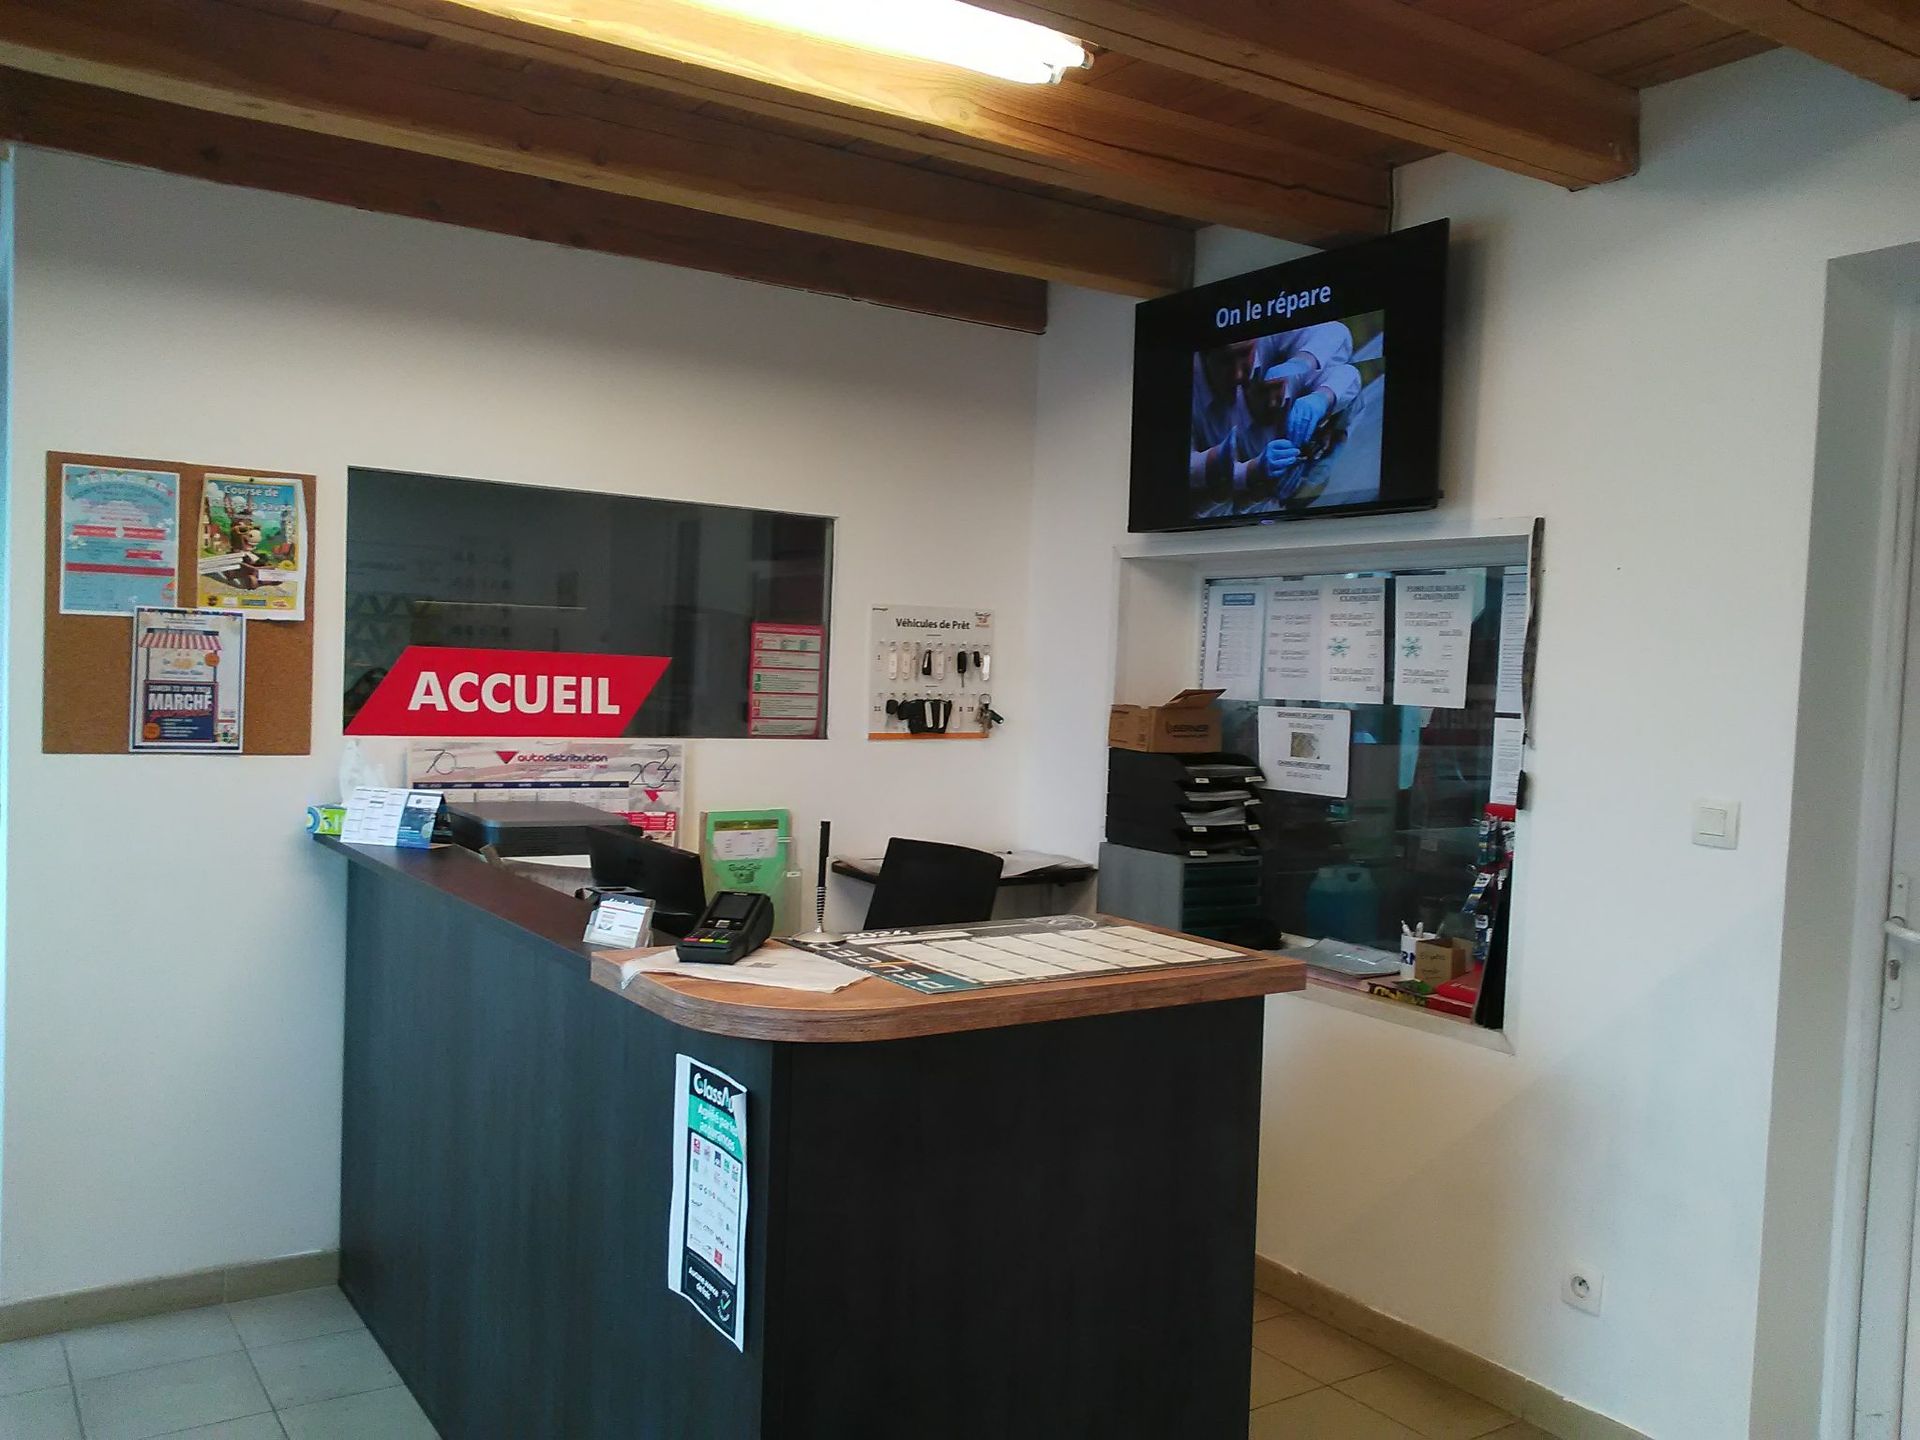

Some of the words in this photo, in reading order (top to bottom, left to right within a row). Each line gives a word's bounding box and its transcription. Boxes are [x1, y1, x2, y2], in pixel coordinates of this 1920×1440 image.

[1216, 307, 1240, 328] On
[1246, 300, 1262, 321] le
[1266, 285, 1332, 318] répare
[895, 618, 938, 629] Véhicules
[939, 620, 950, 629] de
[952, 620, 970, 630] Prêt
[407, 671, 620, 714] ACCUEIL
[517, 751, 609, 763] autodistribution
[804, 942, 954, 990] PEUGEO
